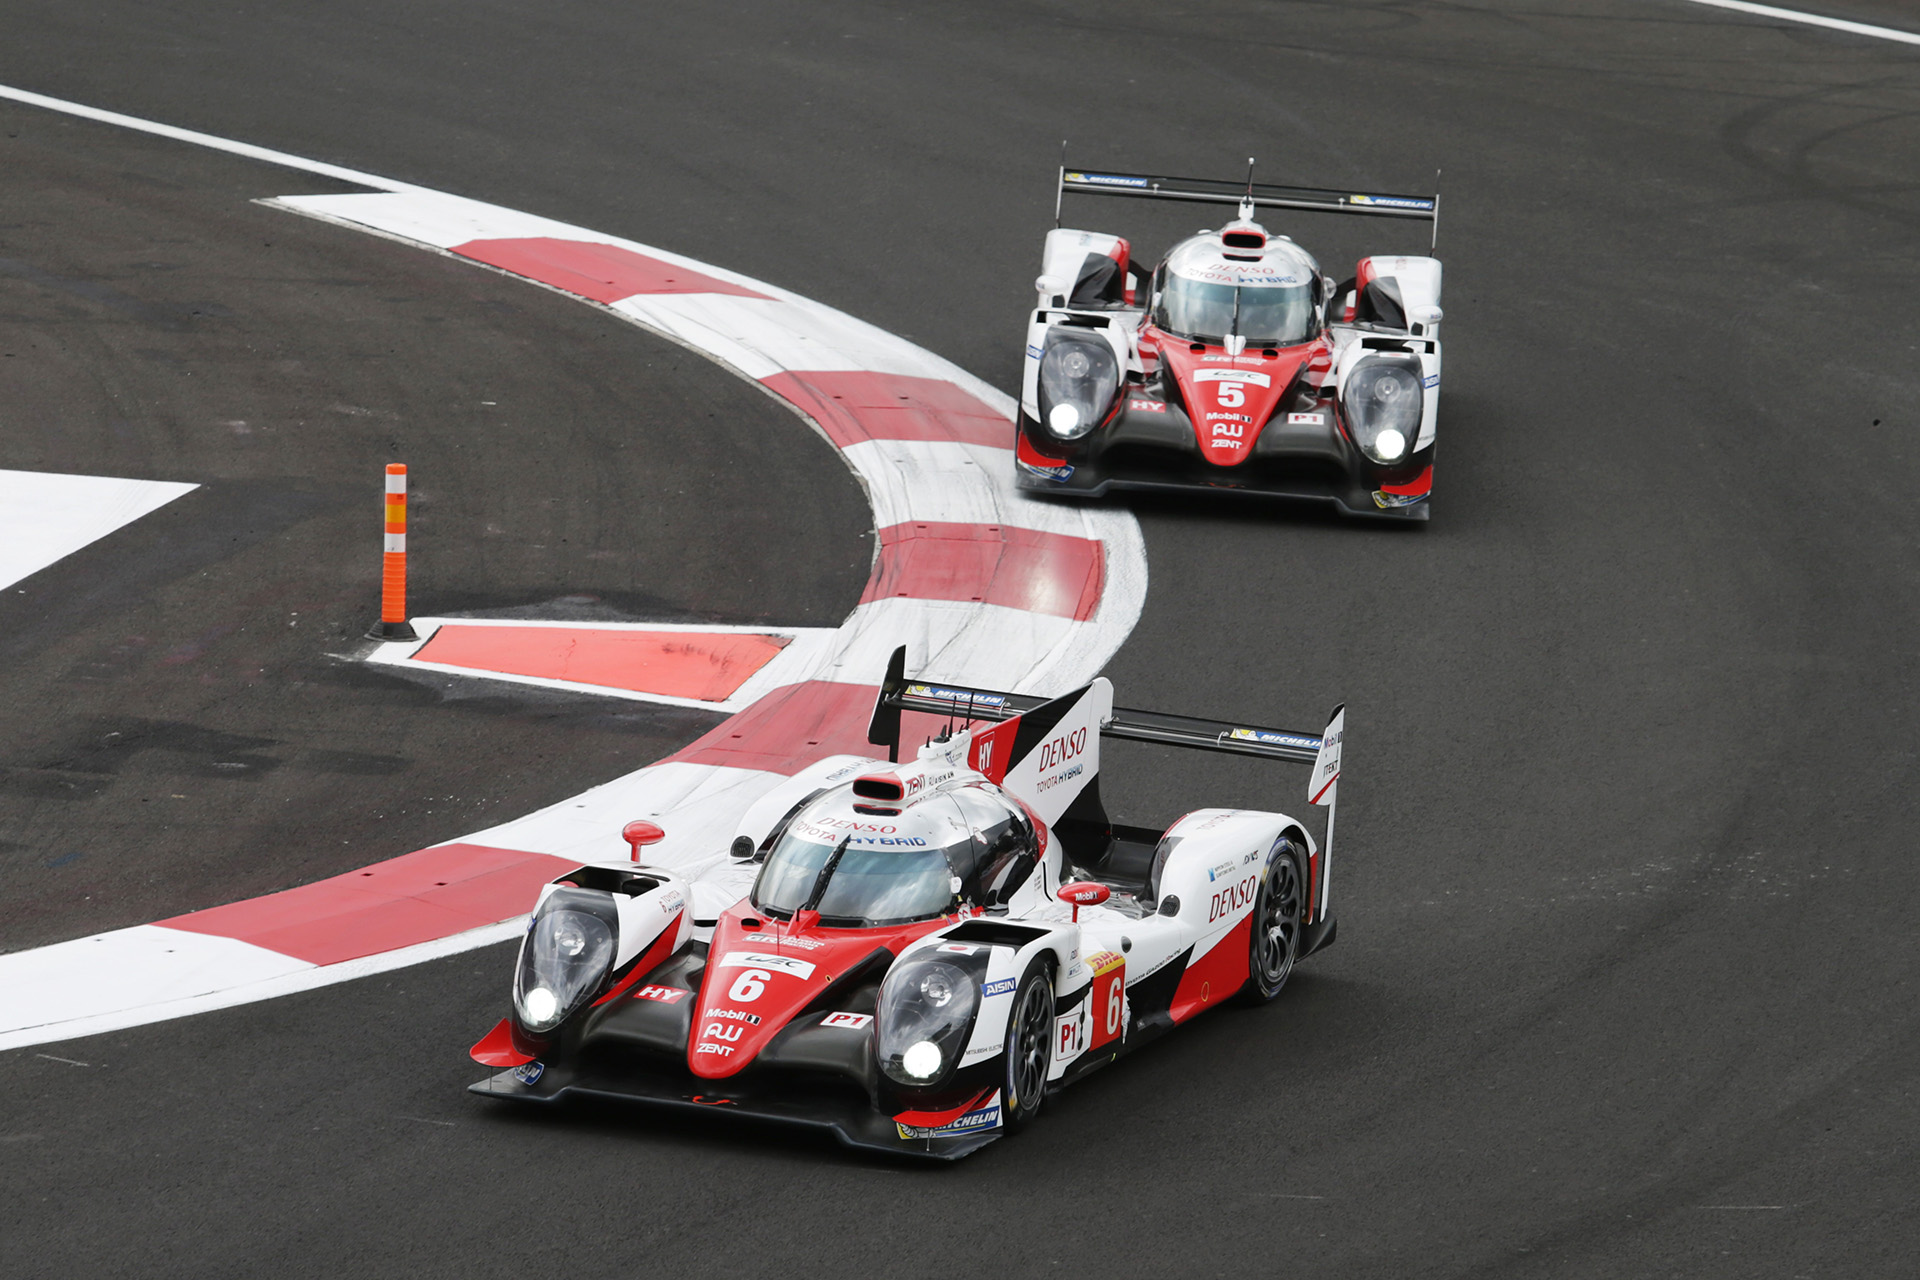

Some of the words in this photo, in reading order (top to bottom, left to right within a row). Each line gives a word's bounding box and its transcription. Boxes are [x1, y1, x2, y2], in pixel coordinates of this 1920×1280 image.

[1089, 176, 1145, 186] MICHELIN
[1375, 198, 1431, 208] MICHELIN
[1186, 268, 1233, 282] TOYOTA
[1239, 275, 1297, 283] HYBRID
[1208, 263, 1275, 275] DENSO
[1217, 381, 1245, 408] 5
[1131, 401, 1163, 410] HY
[1206, 412, 1240, 420] Mobil
[1211, 439, 1243, 449] ZENT
[934, 690, 1002, 704] MICHELIN
[979, 740, 993, 772] HY
[1039, 726, 1087, 773] DENSO
[1036, 775, 1058, 794] TOYOTA
[1058, 763, 1084, 783] HYBRID
[817, 817, 897, 834] DENSO
[794, 821, 836, 842] TOYOTA
[849, 836, 927, 846] HYBRID
[1208, 874, 1256, 923] DENSO
[1091, 951, 1123, 971] DHL
[728, 969, 772, 1002] 6
[986, 981, 1015, 996] AISIN
[638, 986, 684, 1001] HY
[1106, 977, 1122, 1035] 6
[705, 1008, 747, 1021] Mobil
[830, 1014, 864, 1026] P1
[1061, 1021, 1077, 1053] P1
[697, 1043, 735, 1057] ZENT
[936, 1110, 998, 1130] ICHELIN
